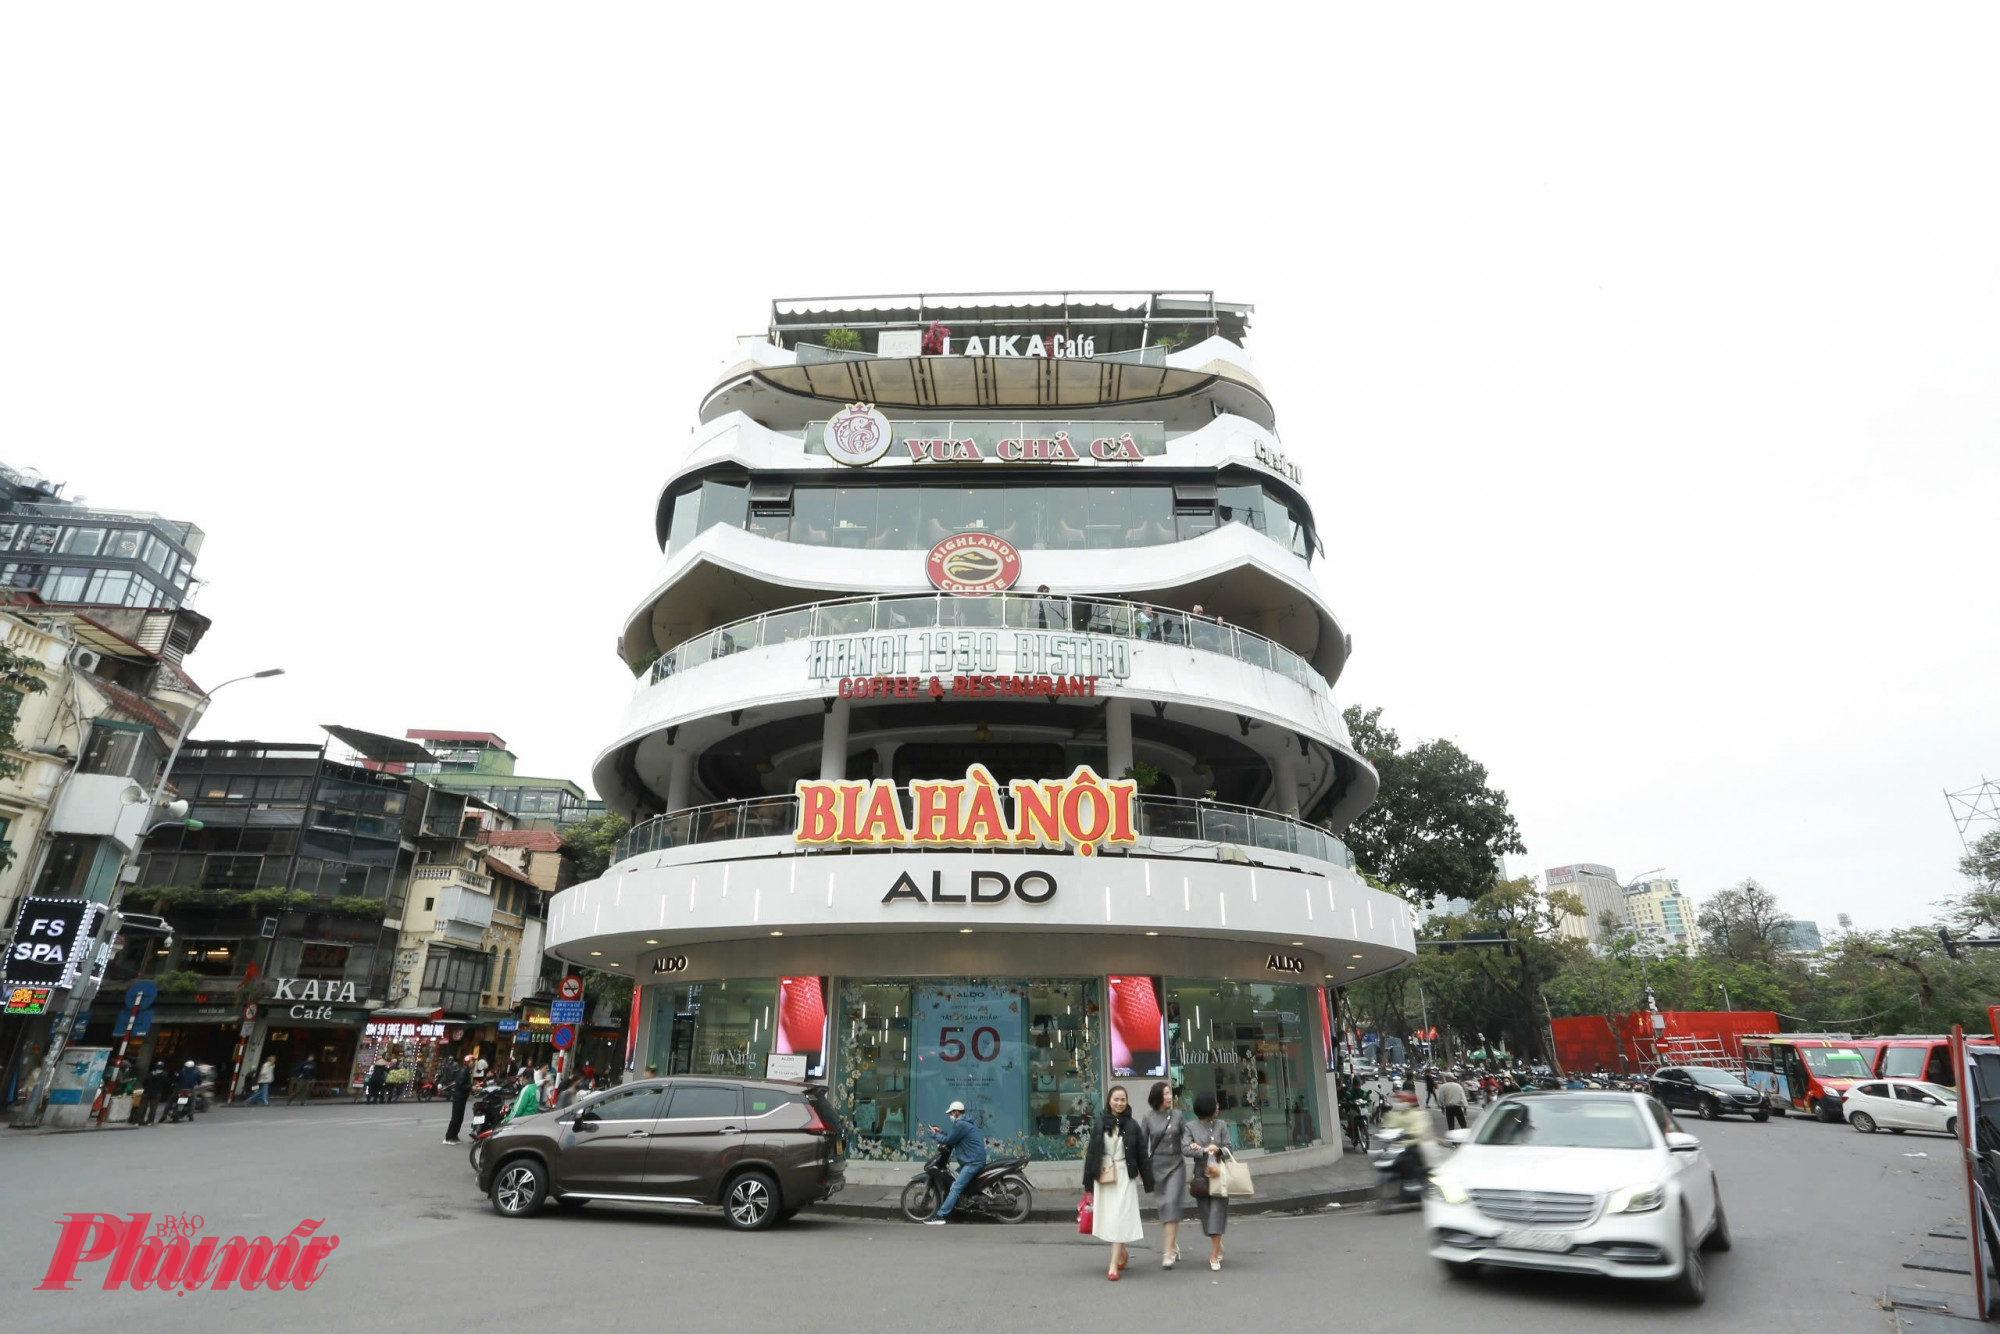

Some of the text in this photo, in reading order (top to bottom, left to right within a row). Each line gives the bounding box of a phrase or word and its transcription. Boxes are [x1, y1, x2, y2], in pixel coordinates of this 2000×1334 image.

[942, 334, 1048, 356] LAIKA
[1053, 334, 1095, 359] Café
[903, 430, 1144, 462] VUA CHẢ CÁ
[931, 536, 1015, 563] HIGHLANDS
[941, 578, 1007, 595] COFFEE
[808, 631, 1131, 680] HANOI 1930 BISTRO
[838, 674, 1099, 699] COFFEE & RESTAURANT
[796, 763, 1137, 857] BIA HÀ NỘI
[880, 869, 1058, 905] ALDO
[30, 919, 65, 936] FS
[14, 942, 63, 962] SPA
[652, 955, 688, 974] ALDO
[1266, 955, 1304, 973] ALDO
[272, 977, 357, 1003] KAFA
[290, 1005, 332, 1020] Café
[939, 1026, 1001, 1062] 50
